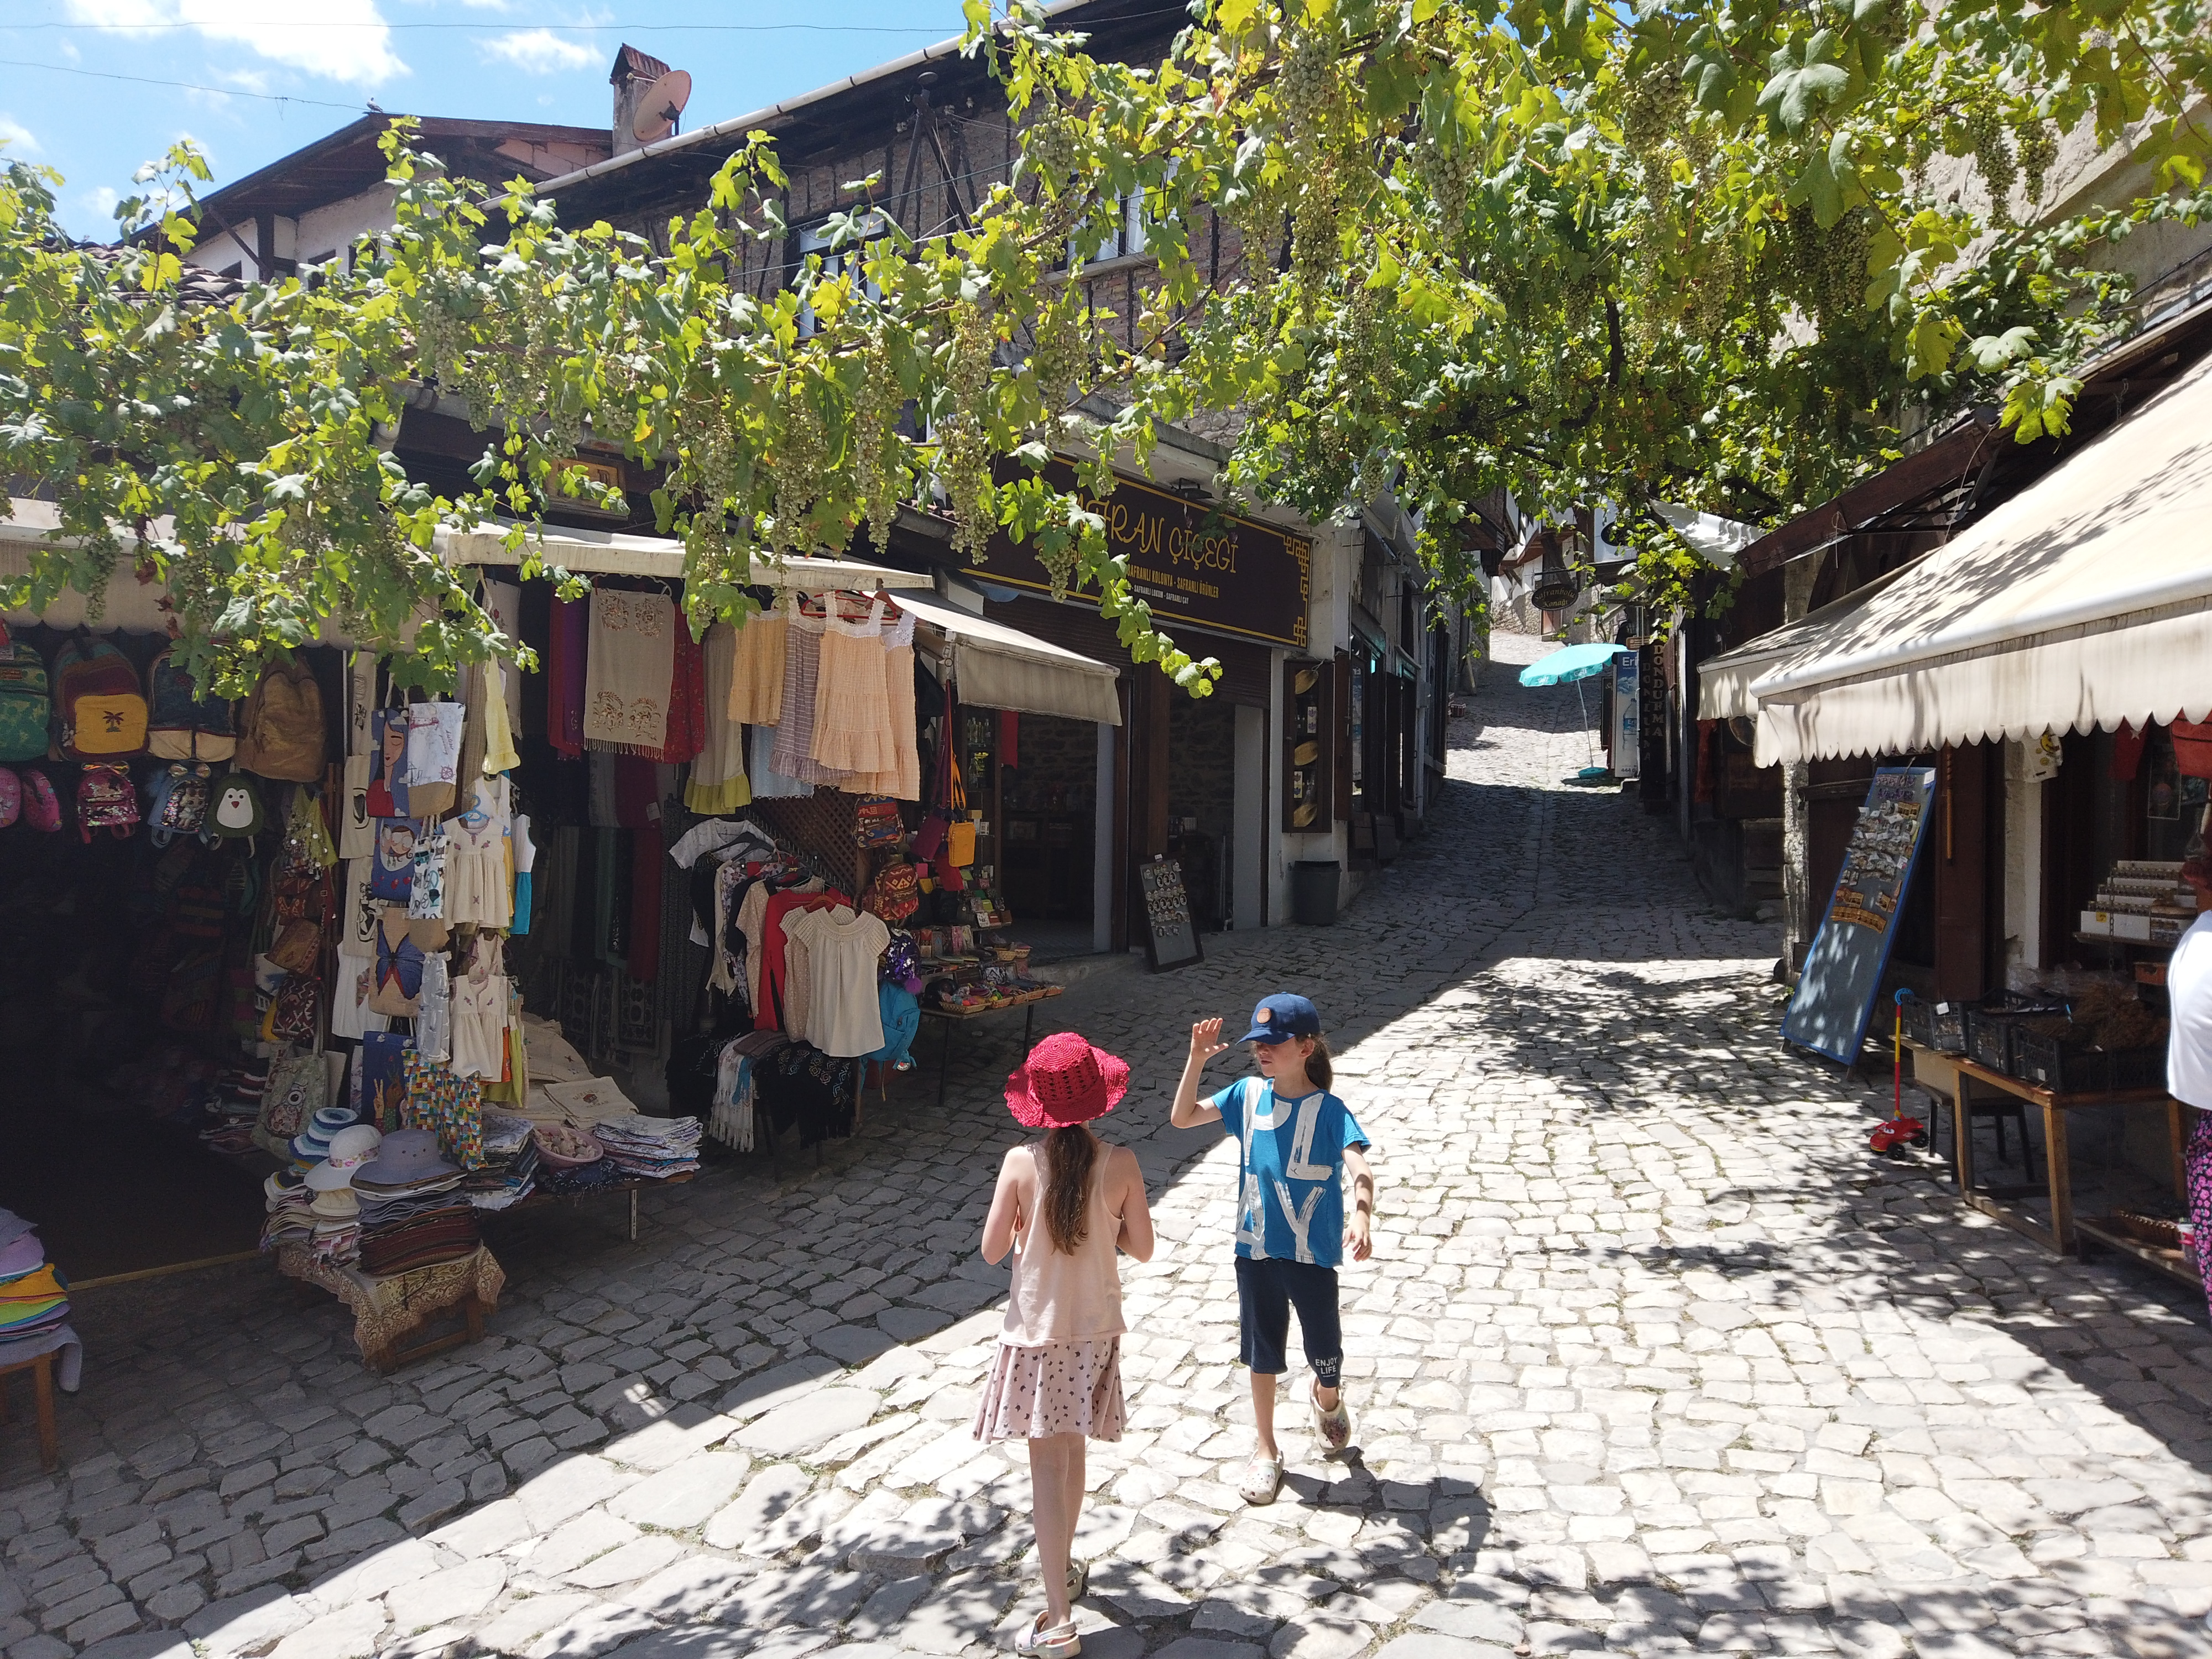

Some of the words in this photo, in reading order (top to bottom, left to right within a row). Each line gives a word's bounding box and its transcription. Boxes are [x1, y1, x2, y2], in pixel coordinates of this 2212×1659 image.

[1128, 564, 1151, 582] SAFRANLI
[1152, 570, 1173, 587] KOLONYA
[1177, 576, 1198, 594] SAFRANLI
[1199, 580, 1219, 598] ÜRÜNLER
[1134, 584, 1151, 596] SAFRANLI
[1535, 587, 1575, 600] Safranbolu
[1315, 1357, 1338, 1366] ENJOY
[1321, 1365, 1337, 1374] LIFE
